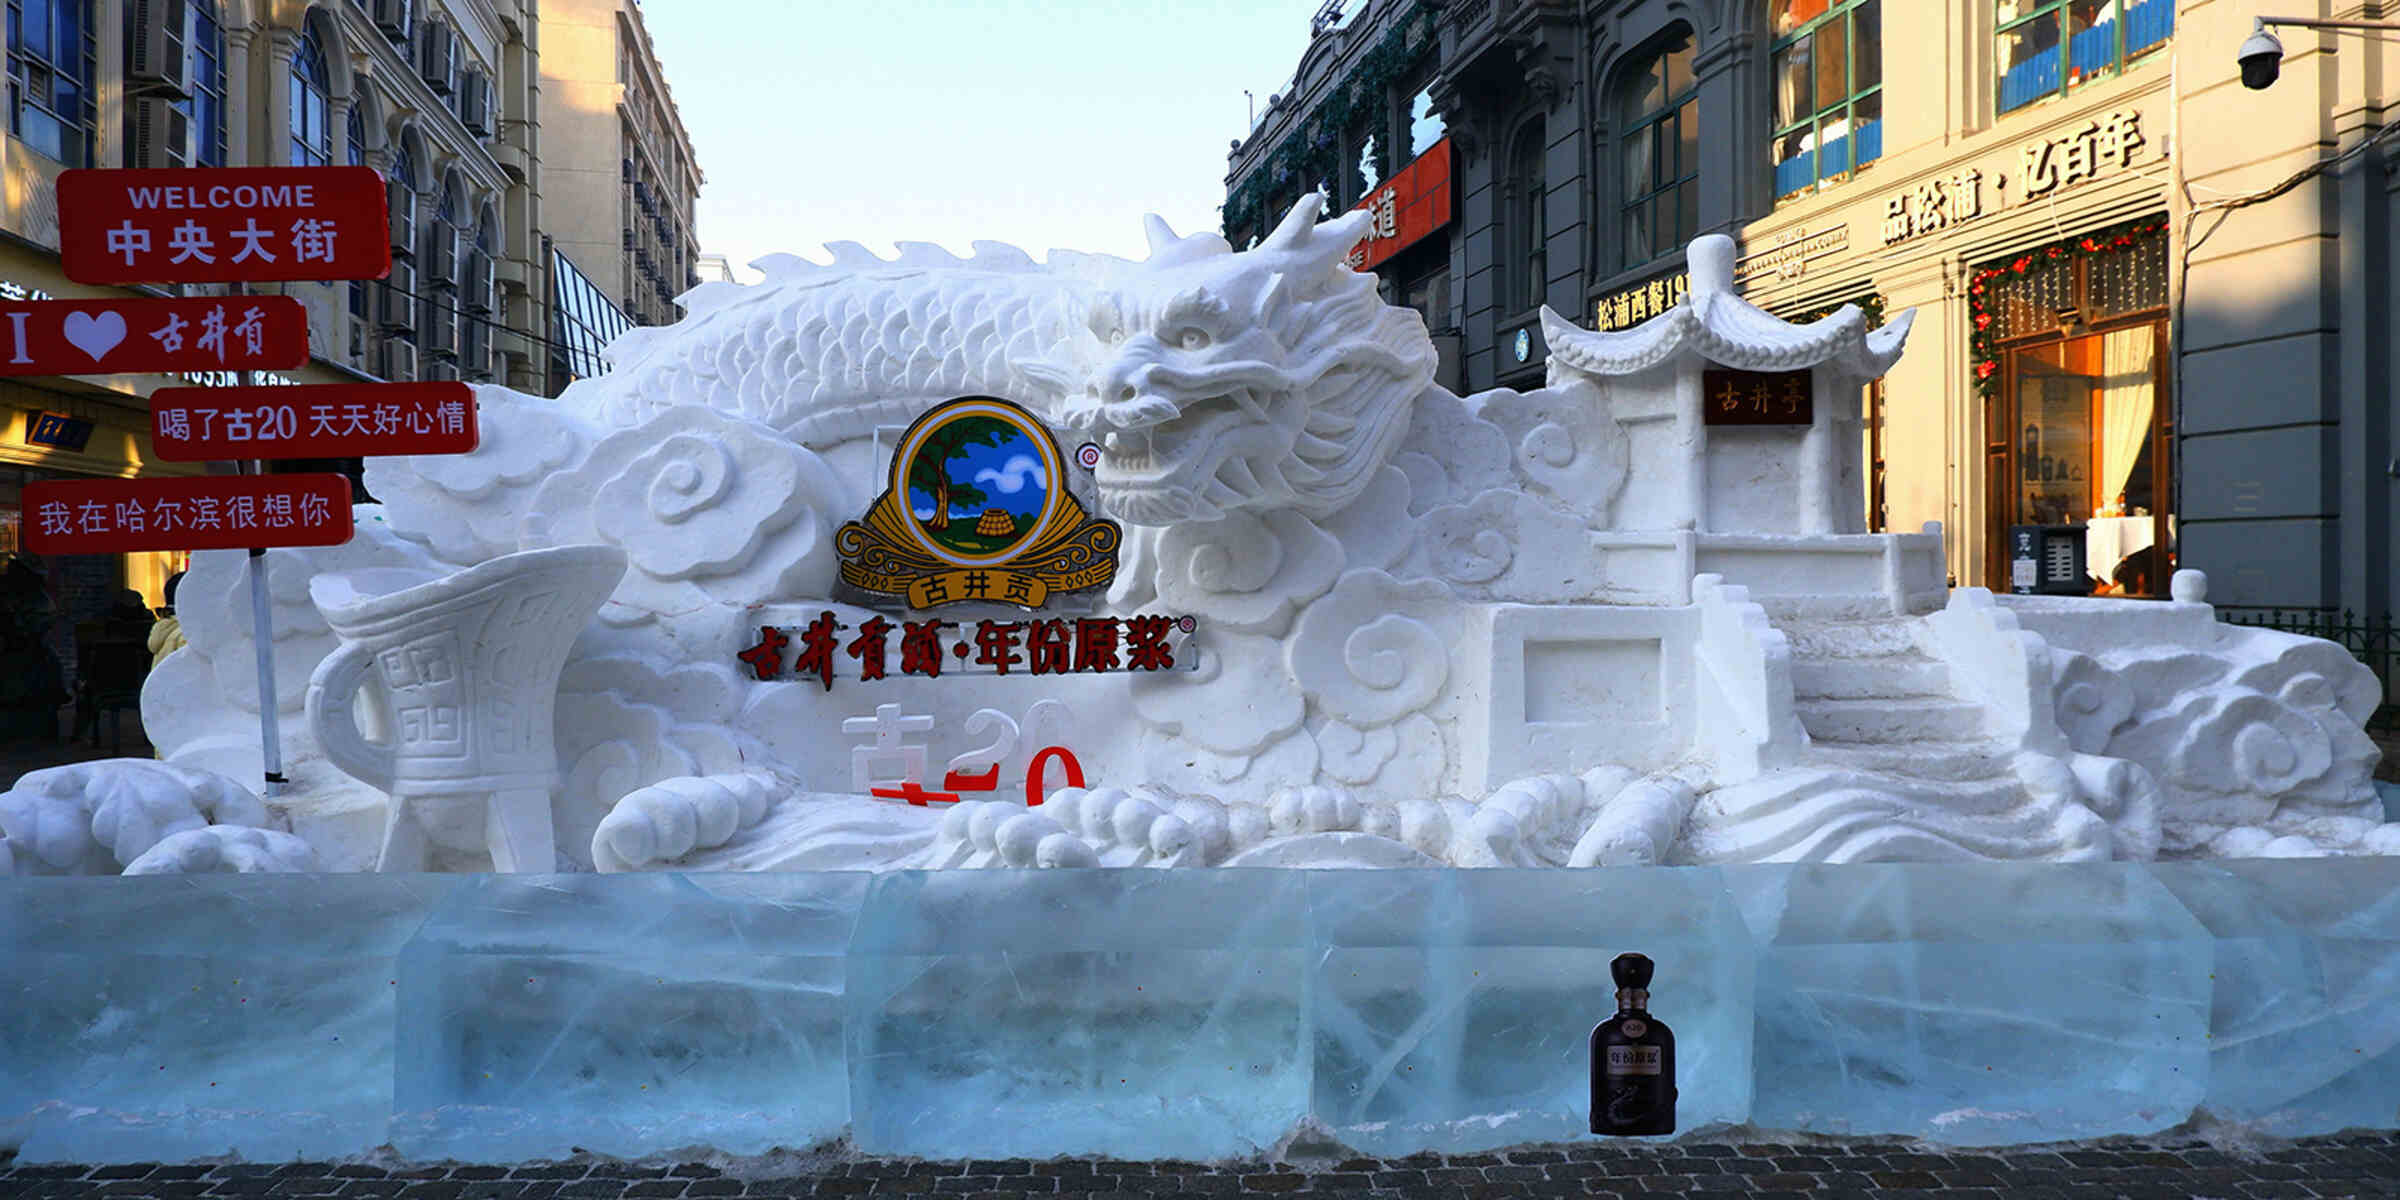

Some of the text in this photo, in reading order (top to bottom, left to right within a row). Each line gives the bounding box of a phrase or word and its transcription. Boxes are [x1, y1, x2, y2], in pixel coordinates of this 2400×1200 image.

[128, 185, 315, 209] WELCOME
[106, 218, 338, 266] 中央大街
[6, 312, 34, 364] I
[1715, 378, 1805, 414] 古井亭
[159, 400, 465, 442] 喝了古20 天天好心情
[39, 493, 330, 536] 我在哈尔滨很想你
[921, 570, 1034, 604] 古井贡
